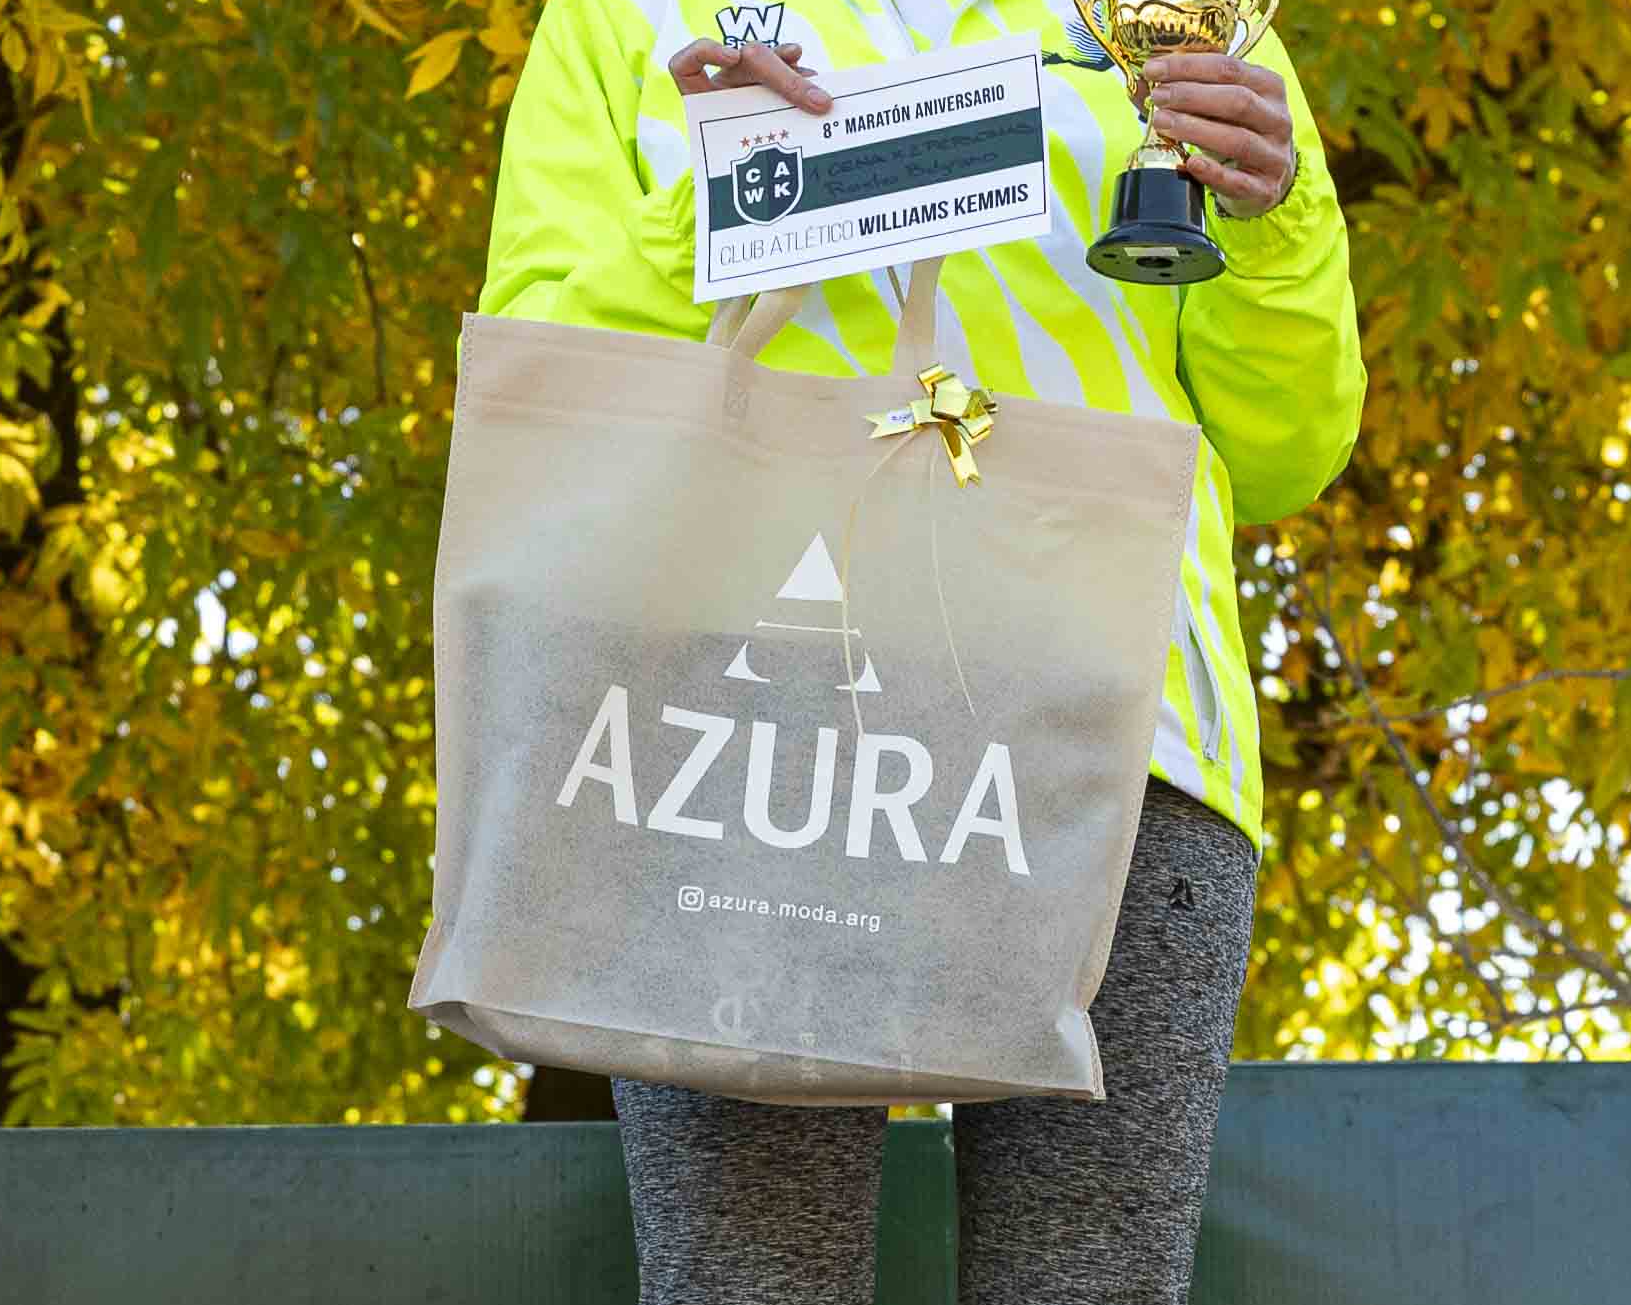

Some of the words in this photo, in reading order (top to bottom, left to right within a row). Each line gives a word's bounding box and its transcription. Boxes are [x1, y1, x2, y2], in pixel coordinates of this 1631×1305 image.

[845, 102, 911, 135] MARATÓN
[915, 84, 1005, 120] ANIVERSARIO
[720, 239, 765, 266] CLUB
[769, 219, 854, 257] ATLÉTICO
[858, 200, 949, 237] WILLIAMS
[954, 183, 1029, 217] KEMMIS
[555, 684, 1030, 875] AZURA
[708, 894, 881, 933] azura.moda.arg
